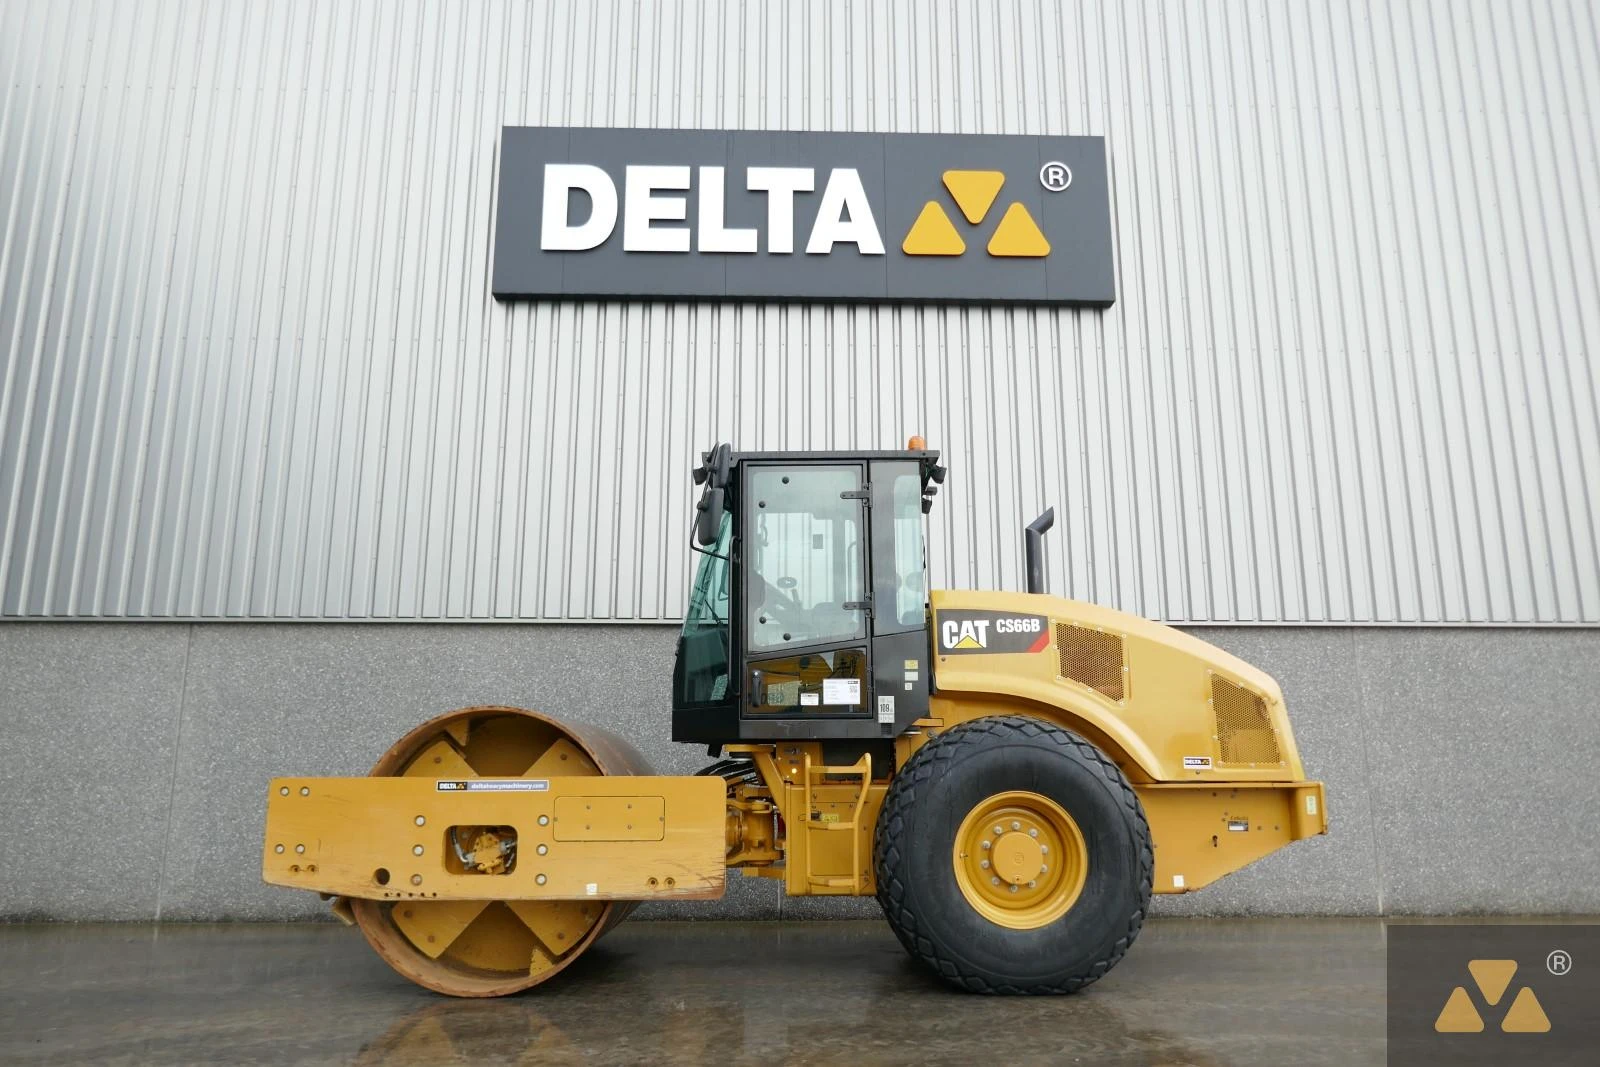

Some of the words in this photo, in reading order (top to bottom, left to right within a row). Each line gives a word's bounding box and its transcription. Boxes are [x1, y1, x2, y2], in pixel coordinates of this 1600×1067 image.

[540, 163, 886, 255] DELTA
[942, 619, 990, 649] CAT
[996, 618, 1041, 633] CS66B
[439, 782, 457, 790] DELTA
